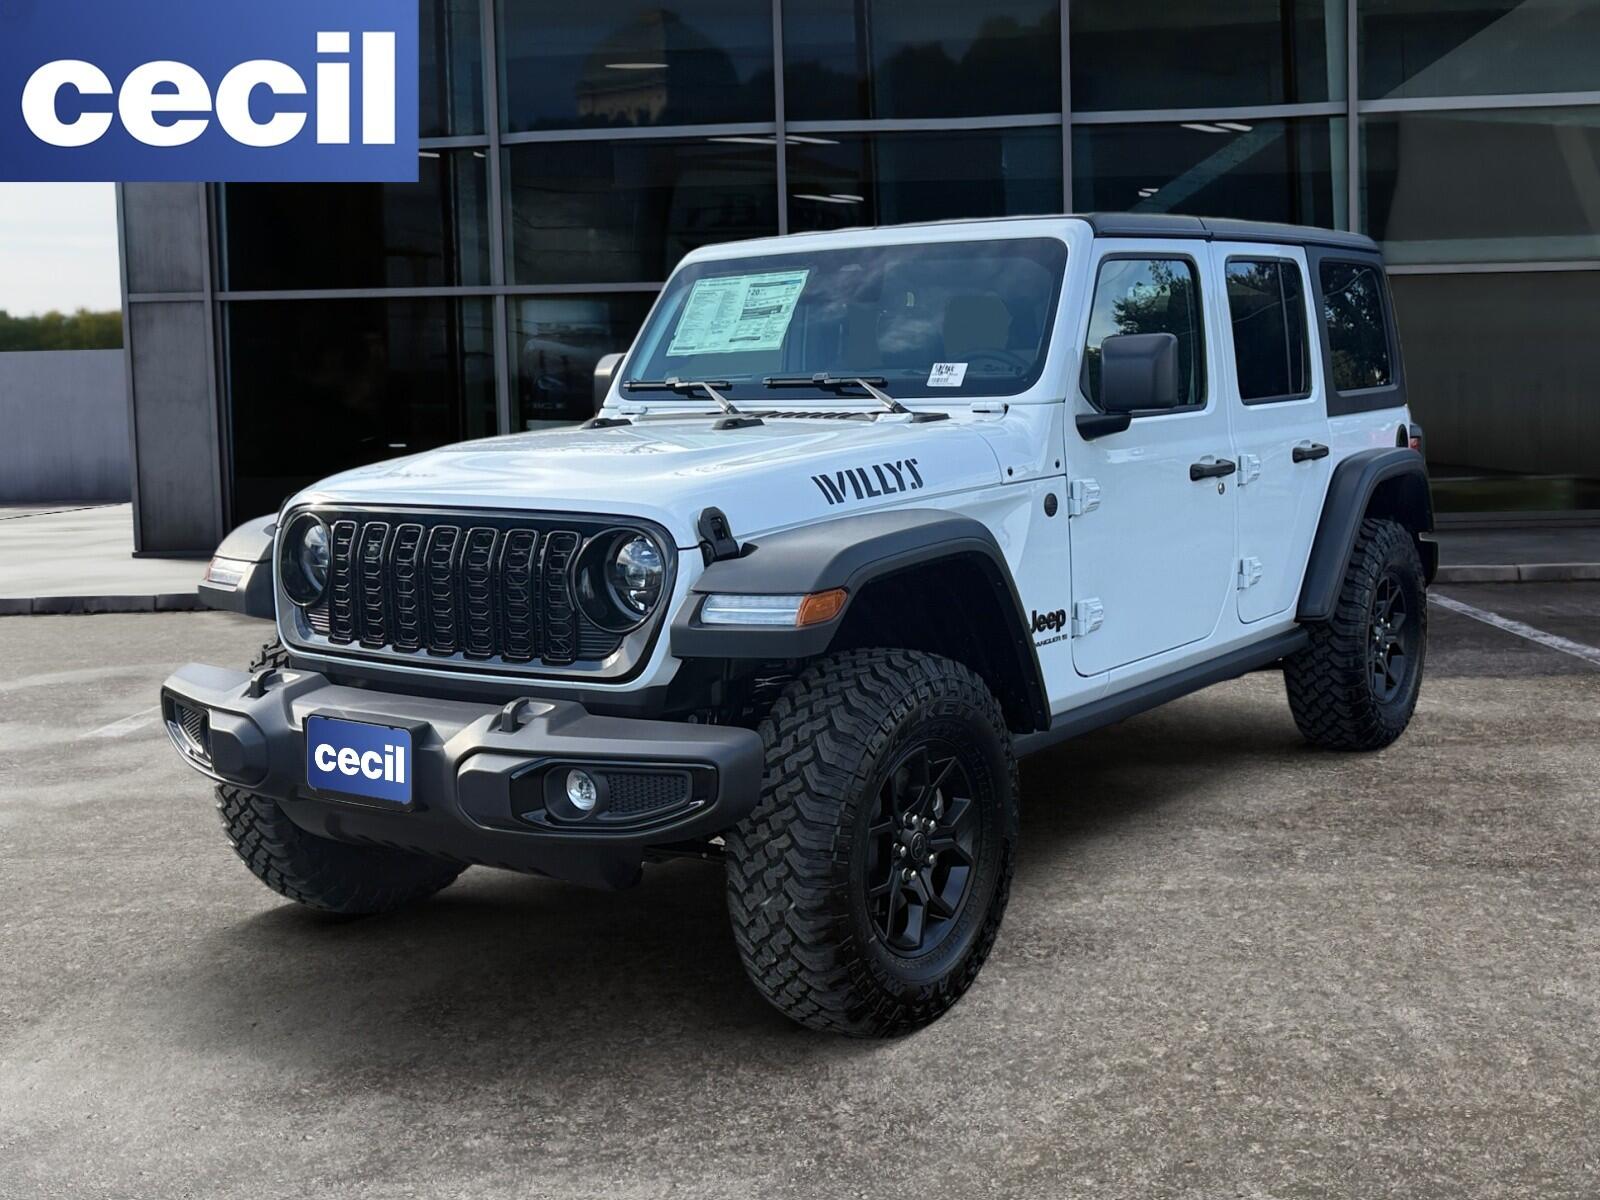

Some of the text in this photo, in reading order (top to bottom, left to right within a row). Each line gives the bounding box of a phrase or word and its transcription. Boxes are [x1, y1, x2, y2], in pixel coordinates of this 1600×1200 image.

[811, 458, 923, 505] WILLYS
[1031, 609, 1066, 633] Jeep
[1035, 635, 1061, 647] ANGLER
[314, 743, 405, 784] cecil
